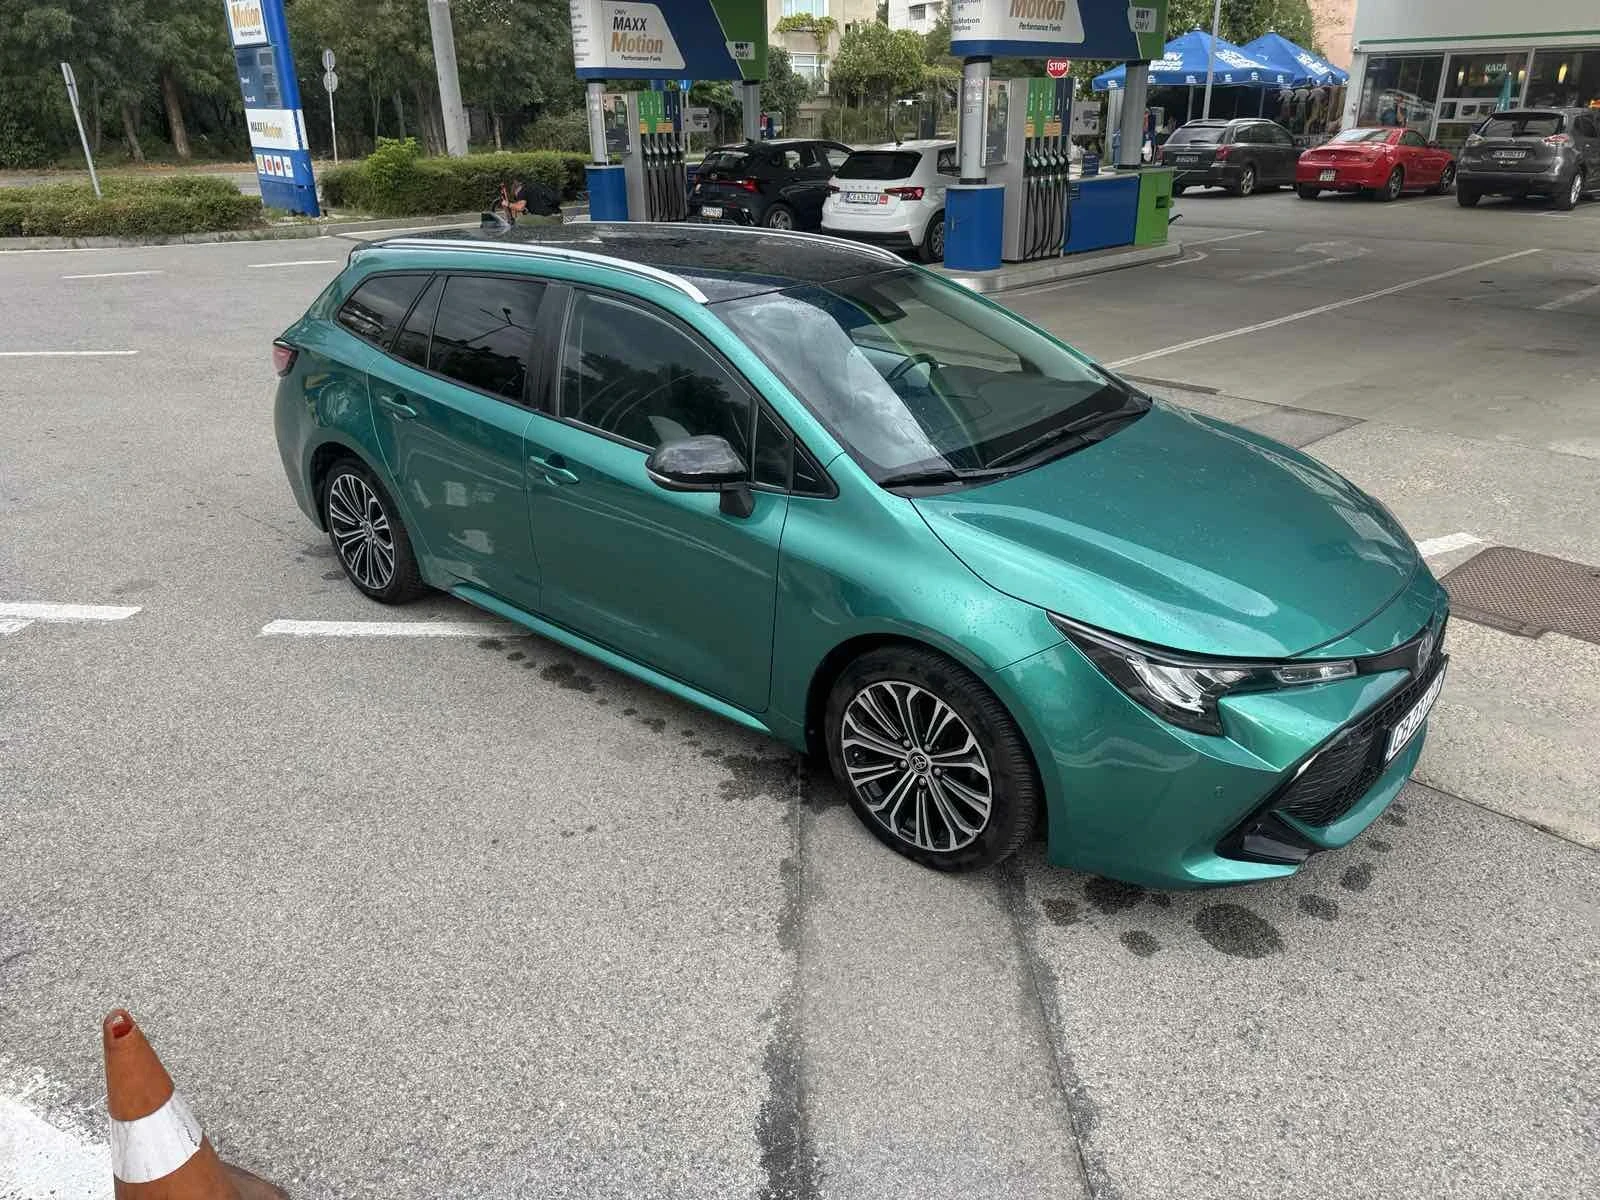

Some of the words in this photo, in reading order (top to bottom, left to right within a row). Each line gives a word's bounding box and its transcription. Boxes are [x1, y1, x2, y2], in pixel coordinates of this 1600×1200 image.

[613, 16, 647, 31] MAXX
[611, 32, 664, 53] Motion
[1049, 62, 1067, 71] STOP
